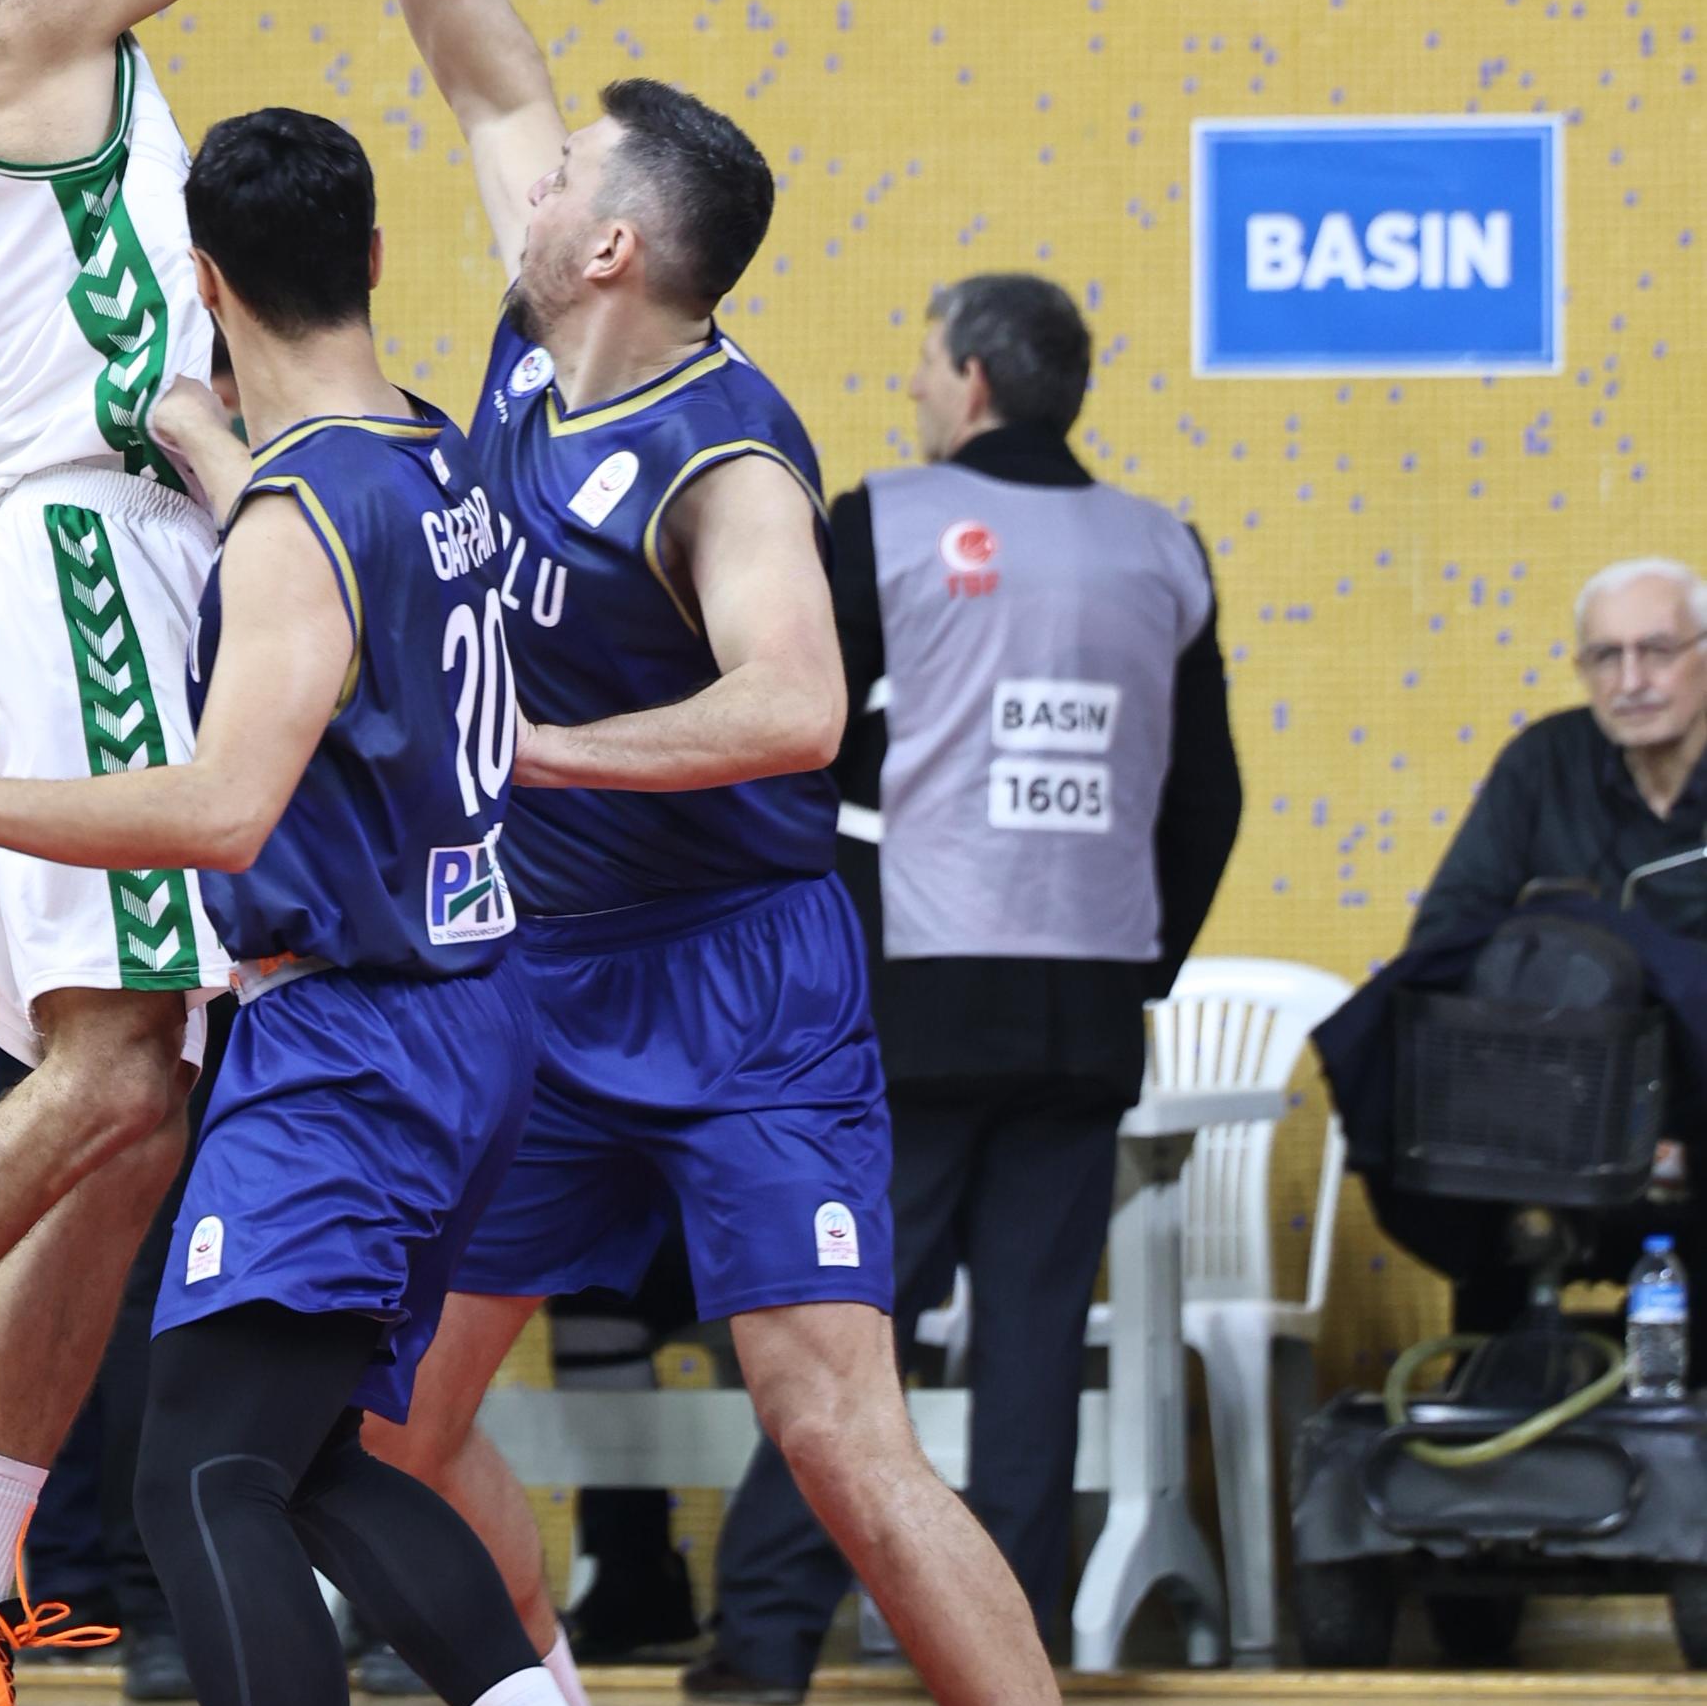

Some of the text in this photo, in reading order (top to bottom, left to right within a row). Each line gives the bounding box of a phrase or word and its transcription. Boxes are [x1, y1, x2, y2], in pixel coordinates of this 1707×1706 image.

[1245, 210, 1512, 292] BASIN
[442, 587, 516, 817] 20
[1001, 699, 1108, 733] BASIN
[1004, 776, 1101, 818] 1605
